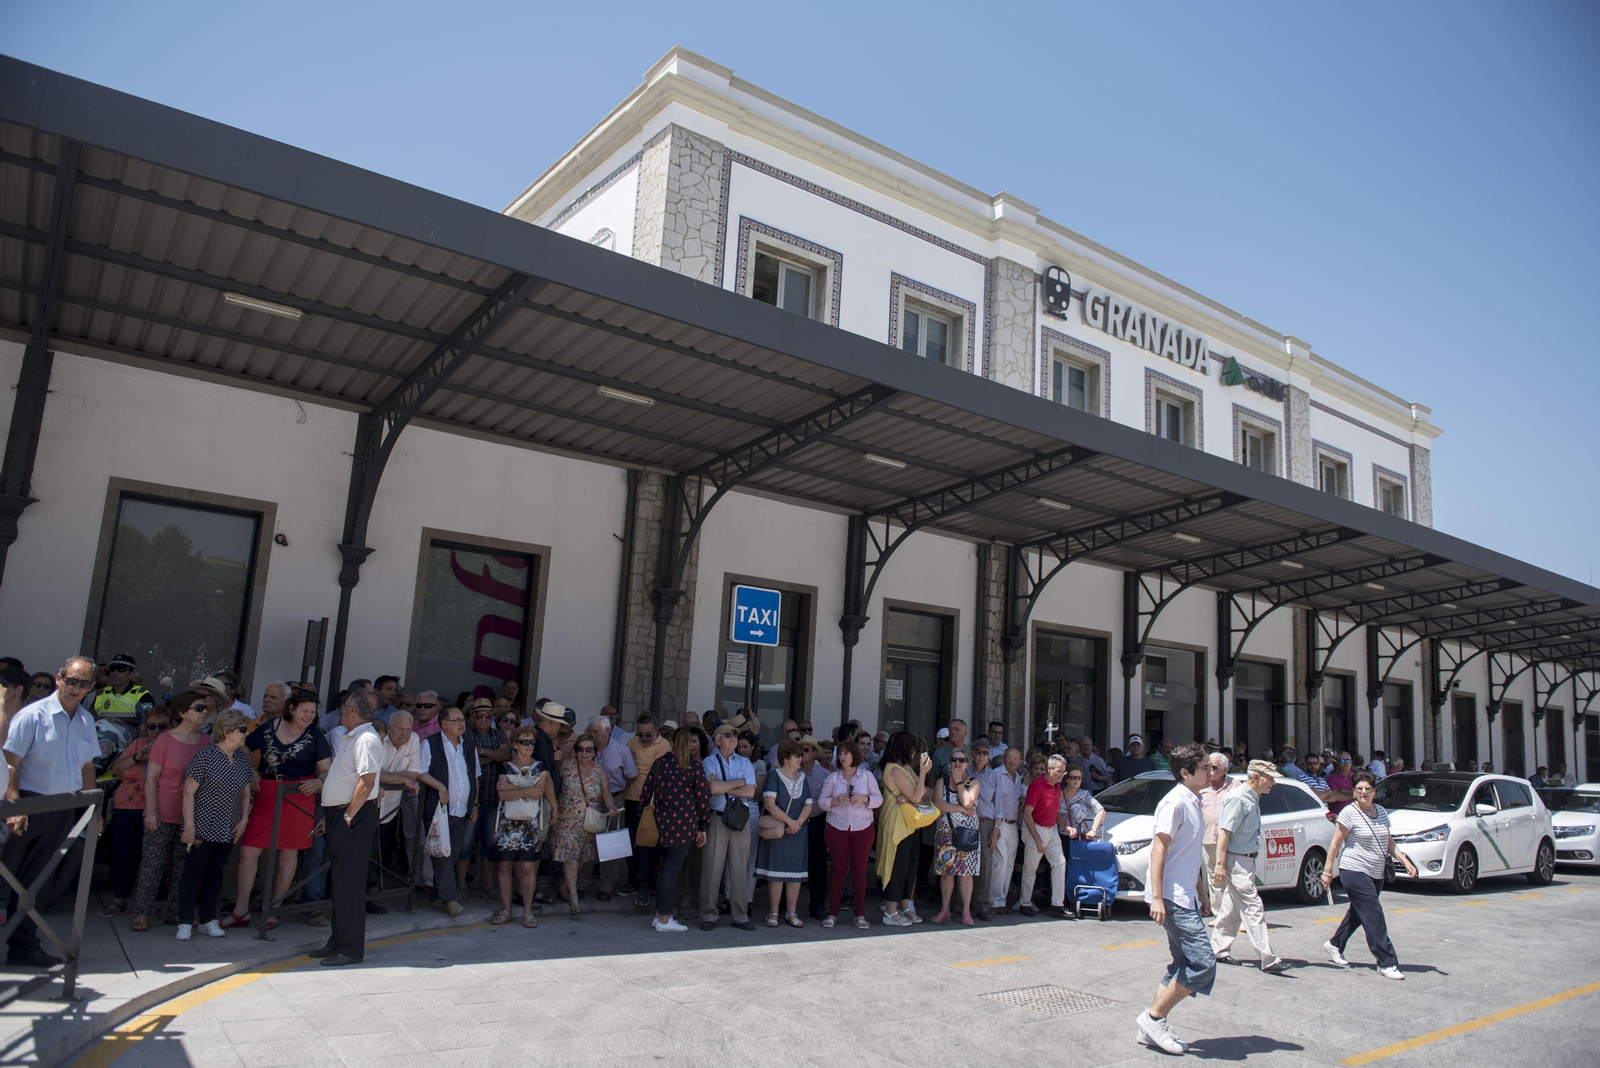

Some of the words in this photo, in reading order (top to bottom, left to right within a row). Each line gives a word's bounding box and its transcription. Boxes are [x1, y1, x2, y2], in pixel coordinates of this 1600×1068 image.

[1082, 289, 1212, 376] GRANADA
[737, 605, 777, 627] TAXI
[1278, 843, 1294, 855] ASC
